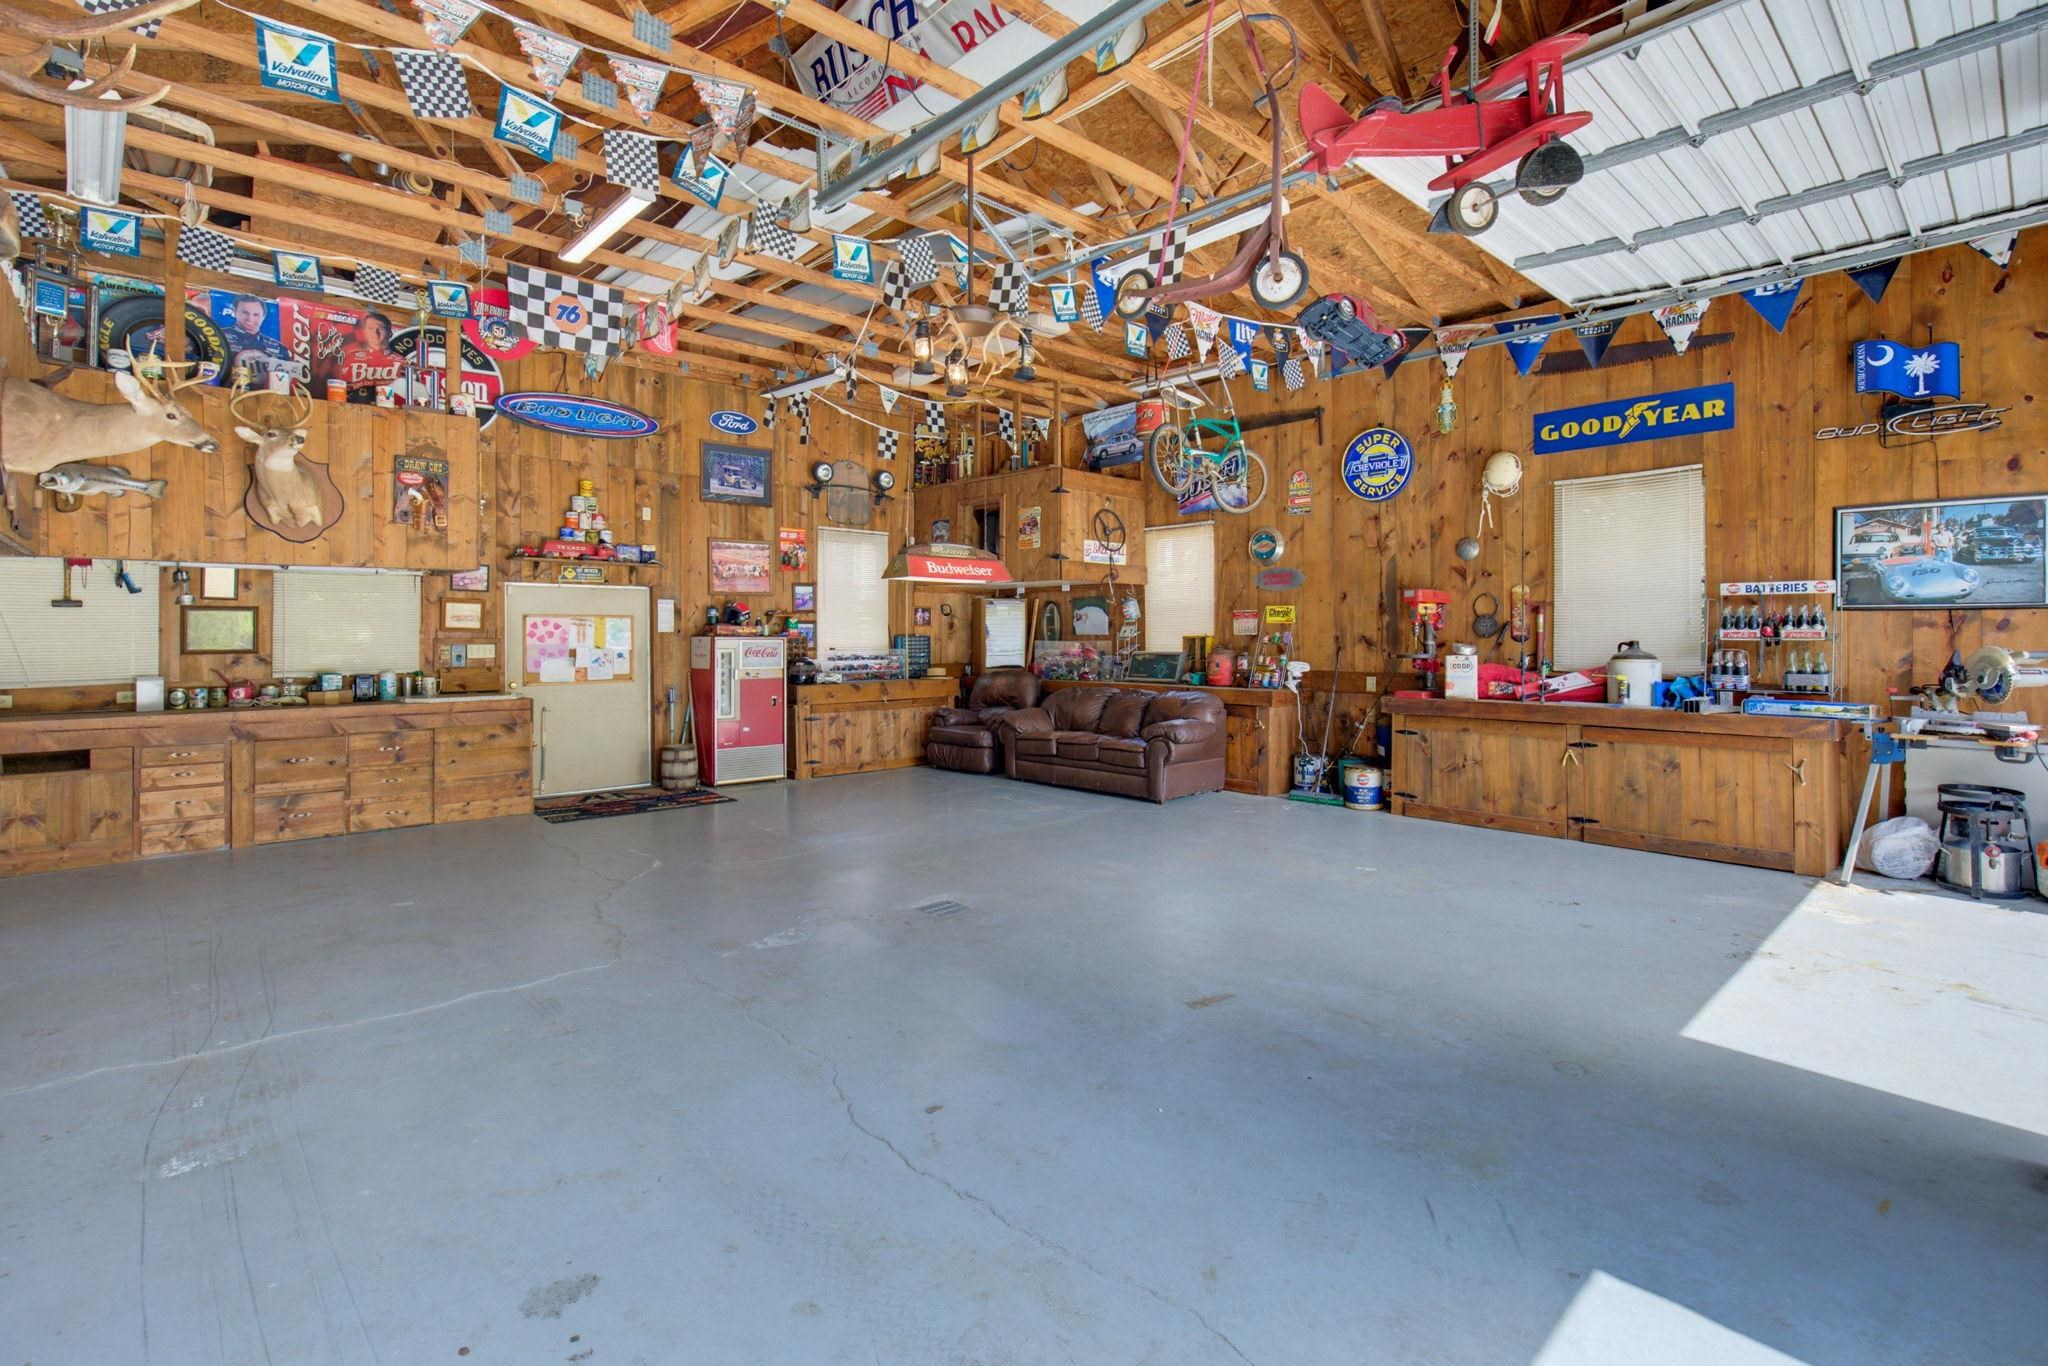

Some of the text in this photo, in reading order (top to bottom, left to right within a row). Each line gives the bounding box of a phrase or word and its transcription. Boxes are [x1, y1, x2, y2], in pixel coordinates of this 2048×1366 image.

[271, 60, 330, 83] Valvoline
[276, 79, 328, 97] MOTOR OILS
[504, 119, 549, 146] Valvoline
[90, 230, 133, 246] Valvoline
[839, 259, 868, 272] Valvoline
[281, 271, 317, 282] Valvoline
[437, 301, 467, 312] Valvoline
[555, 304, 581, 325] 76
[1191, 307, 1219, 324] Miller
[1665, 312, 1699, 328] RACING
[292, 303, 312, 384] eiser
[395, 337, 414, 354] NO
[351, 361, 401, 382] Bud
[1856, 343, 1866, 392] SOUTH CAROLINA
[515, 401, 642, 428] BUD LIGHT
[718, 413, 750, 432] Ford
[1816, 407, 2010, 440] BUD LIGHT
[1355, 433, 1401, 454] SUPER
[404, 459, 443, 473] DRAW ONE
[1353, 458, 1406, 473] CHEVROLET
[1353, 473, 1404, 497] SERVICE
[556, 544, 587, 552] TEXACO
[926, 560, 993, 577] Budweiser
[1911, 567, 1941, 577] 130
[1745, 582, 1808, 594] BATTERIES
[744, 646, 778, 659] Coca-Cola
